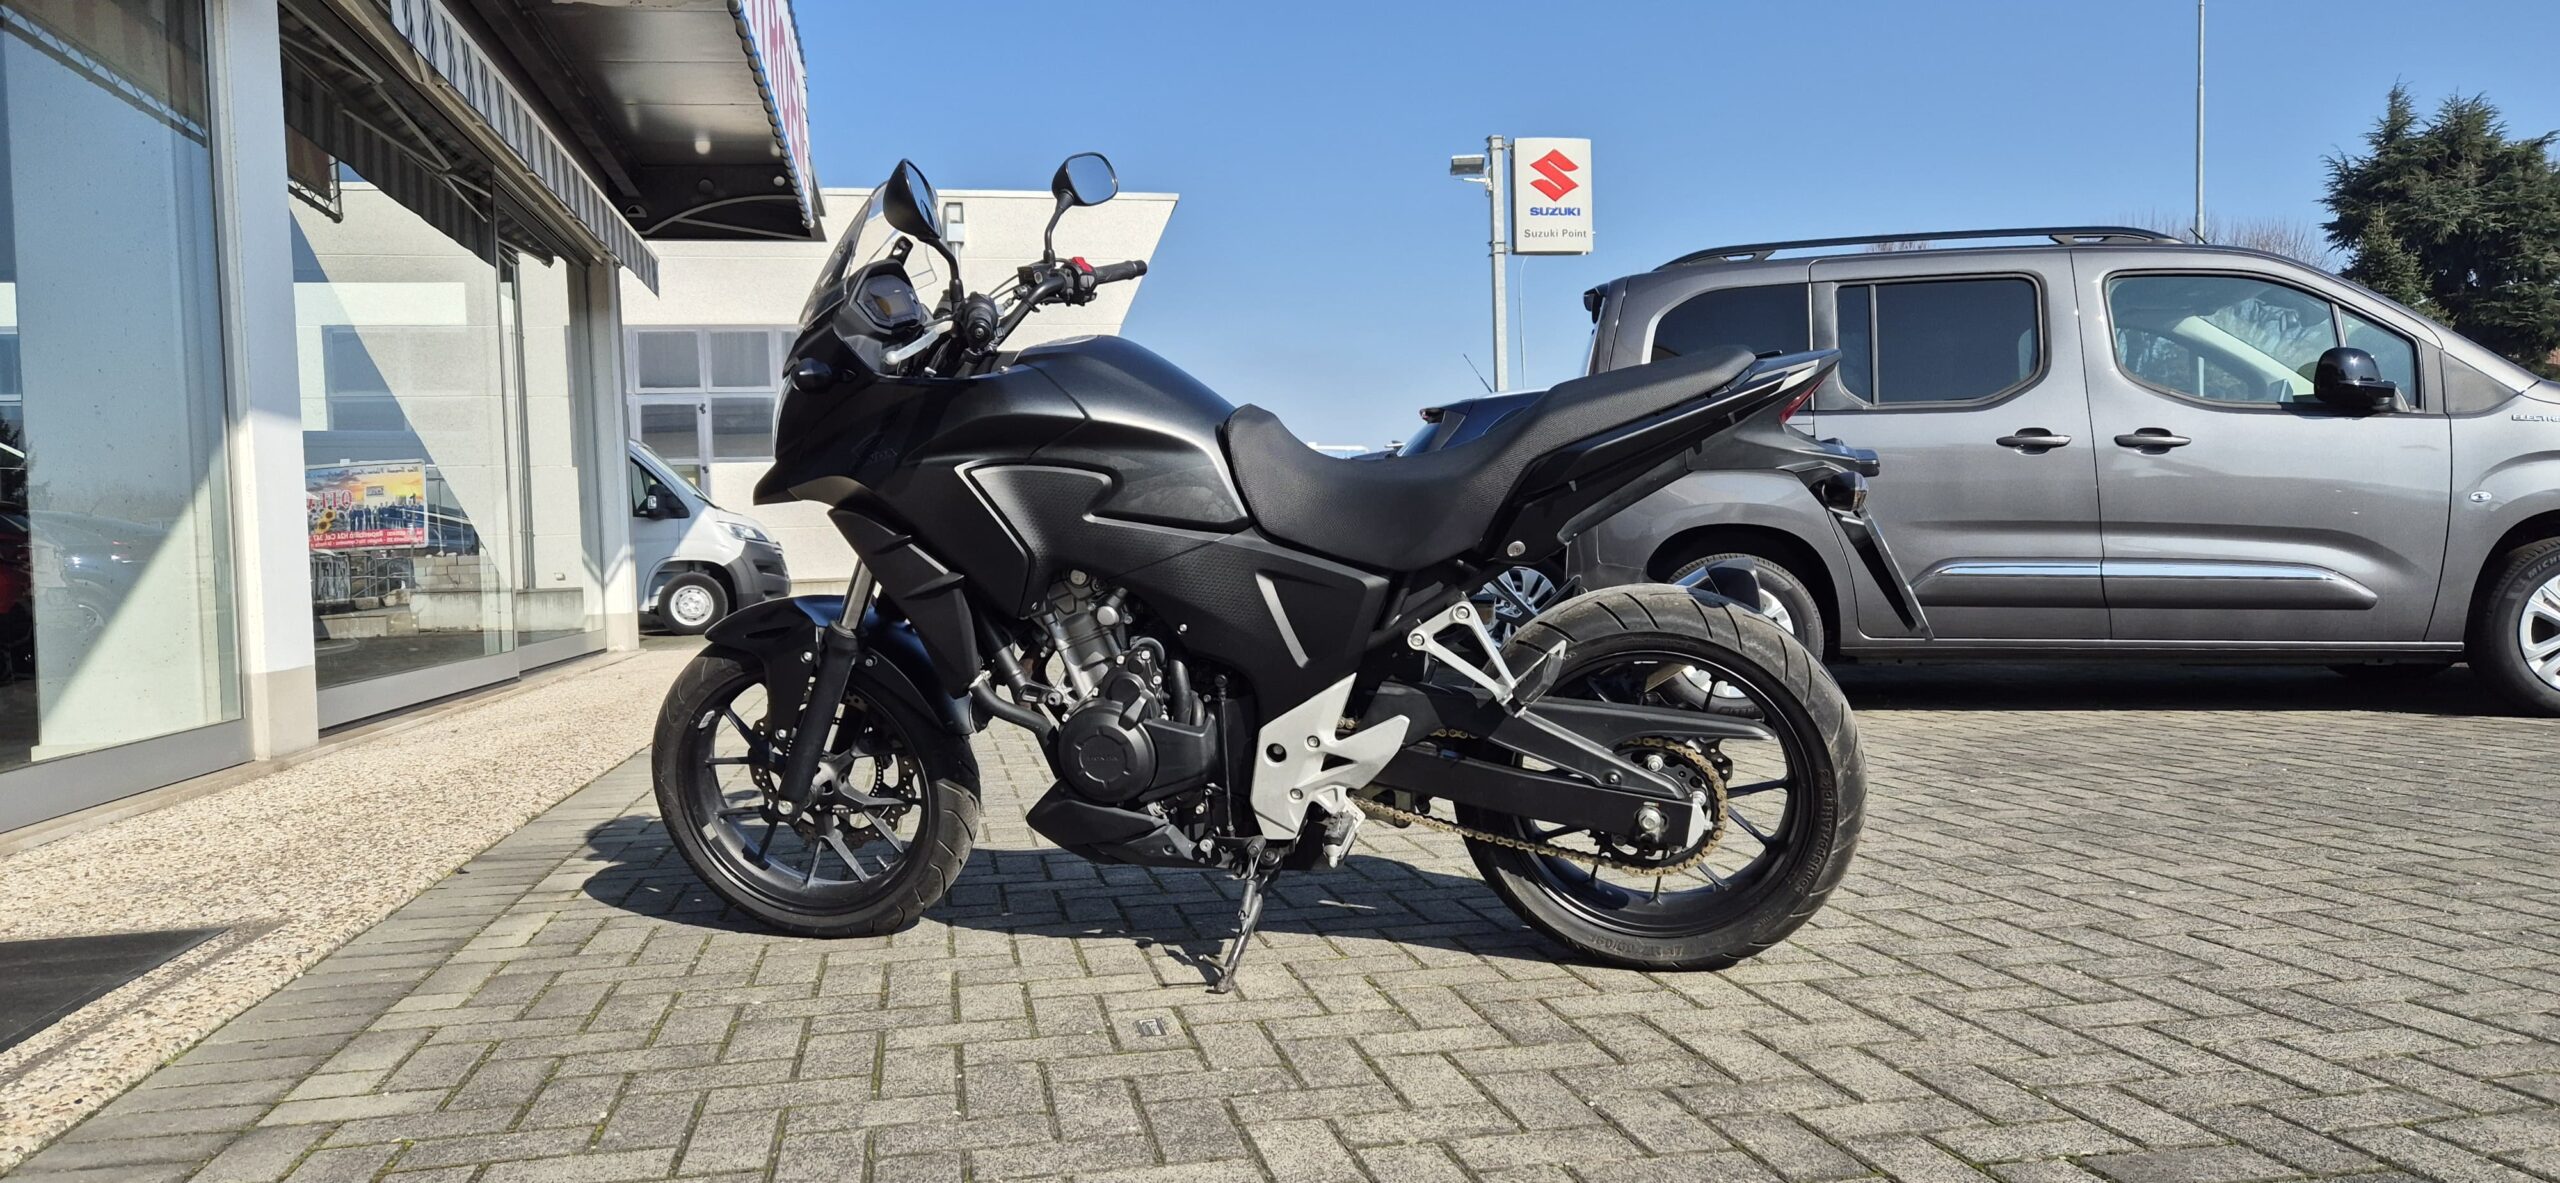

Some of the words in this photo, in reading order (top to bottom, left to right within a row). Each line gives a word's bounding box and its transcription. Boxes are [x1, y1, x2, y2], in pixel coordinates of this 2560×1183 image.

[1529, 207, 1581, 216] SUZUKI
[1524, 229, 1559, 238] Suzuki
[1562, 229, 1587, 238] Point
